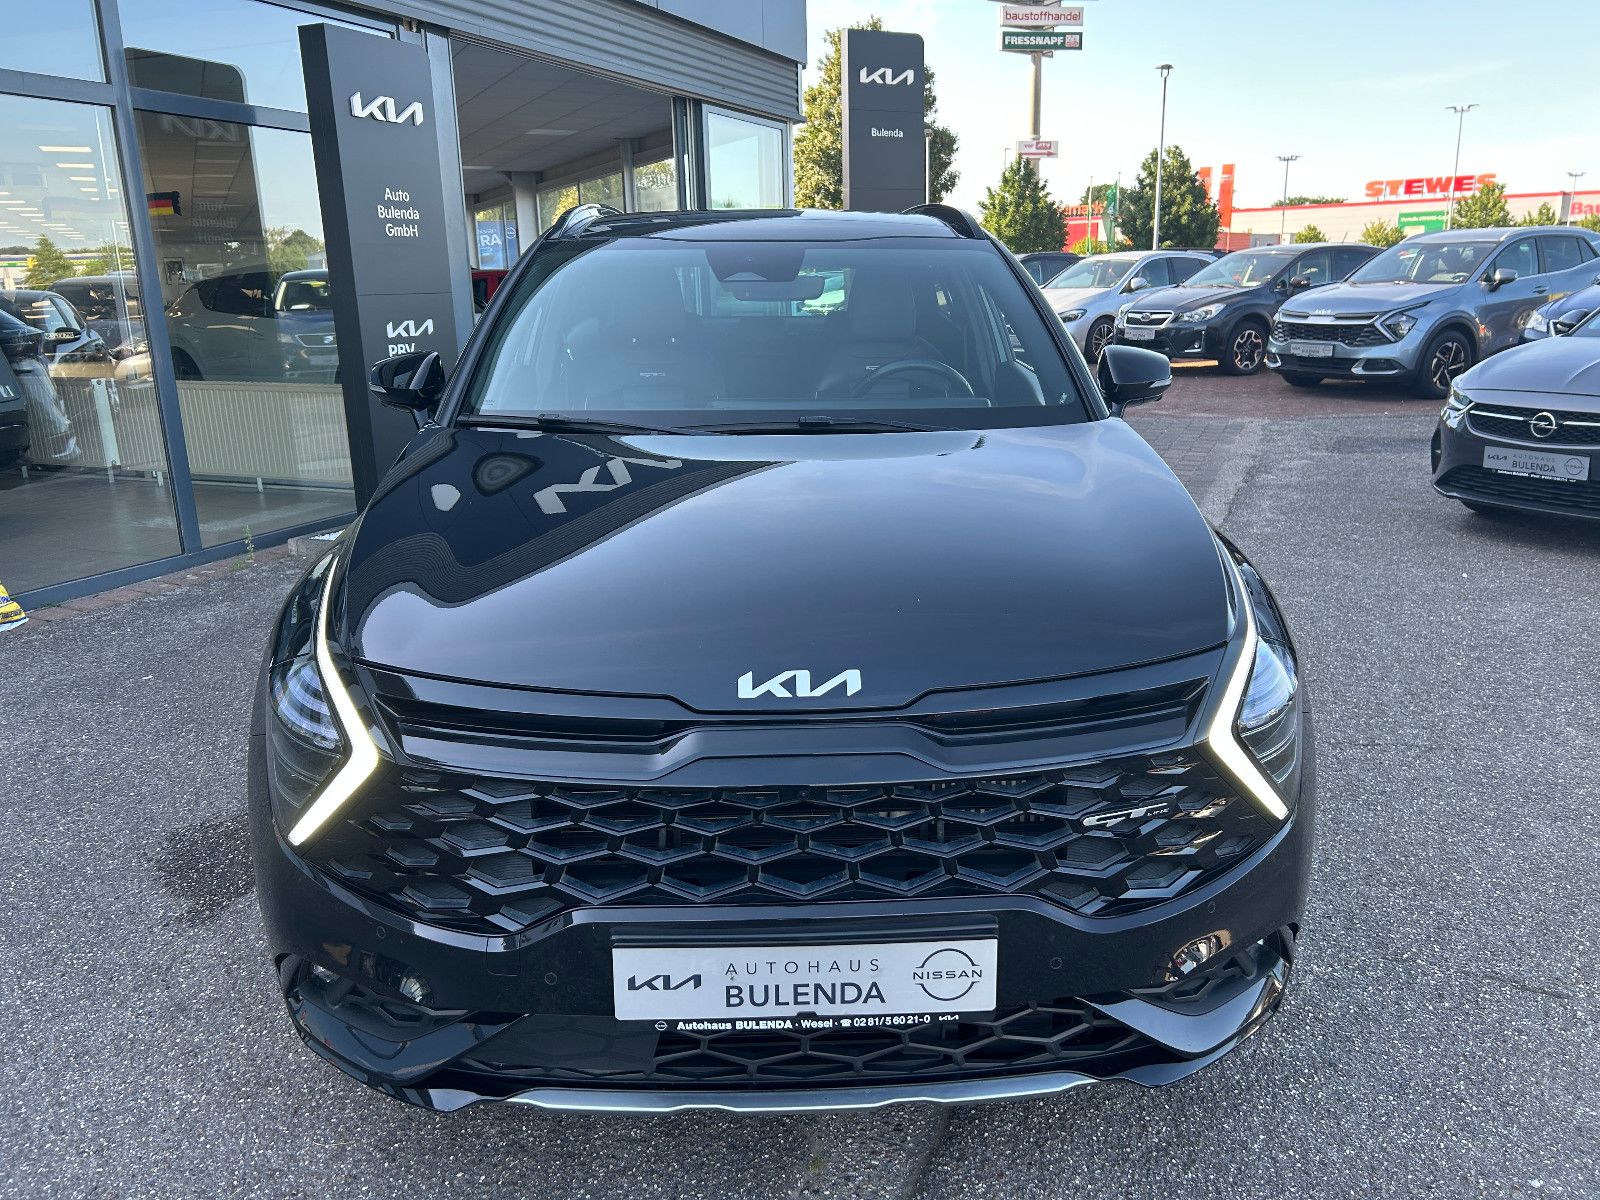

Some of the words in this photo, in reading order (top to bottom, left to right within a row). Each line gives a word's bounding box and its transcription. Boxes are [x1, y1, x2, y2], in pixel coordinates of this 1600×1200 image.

[1005, 11, 1081, 21] baustoffhandel
[1004, 36, 1064, 45] FRESSNAPF
[860, 66, 914, 86] KIA
[350, 92, 424, 126] KIA
[871, 127, 904, 138] Bulenda
[1365, 173, 1497, 197] STEWES
[384, 188, 410, 202] Auto
[377, 205, 420, 220] Bulenda
[385, 223, 419, 237] GmbH
[480, 233, 502, 247] RA
[387, 318, 433, 338] KIA
[1512, 460, 1556, 473] BULENDA
[737, 669, 861, 698] KIA
[725, 958, 881, 976] AUTOHAUS
[912, 968, 983, 981] NISSAN
[627, 974, 702, 991] KIA
[725, 981, 886, 1008] BULENDA
[677, 1020, 732, 1031] Autohaus
[735, 1019, 793, 1030] BULENDA
[801, 1018, 833, 1028] Wesel
